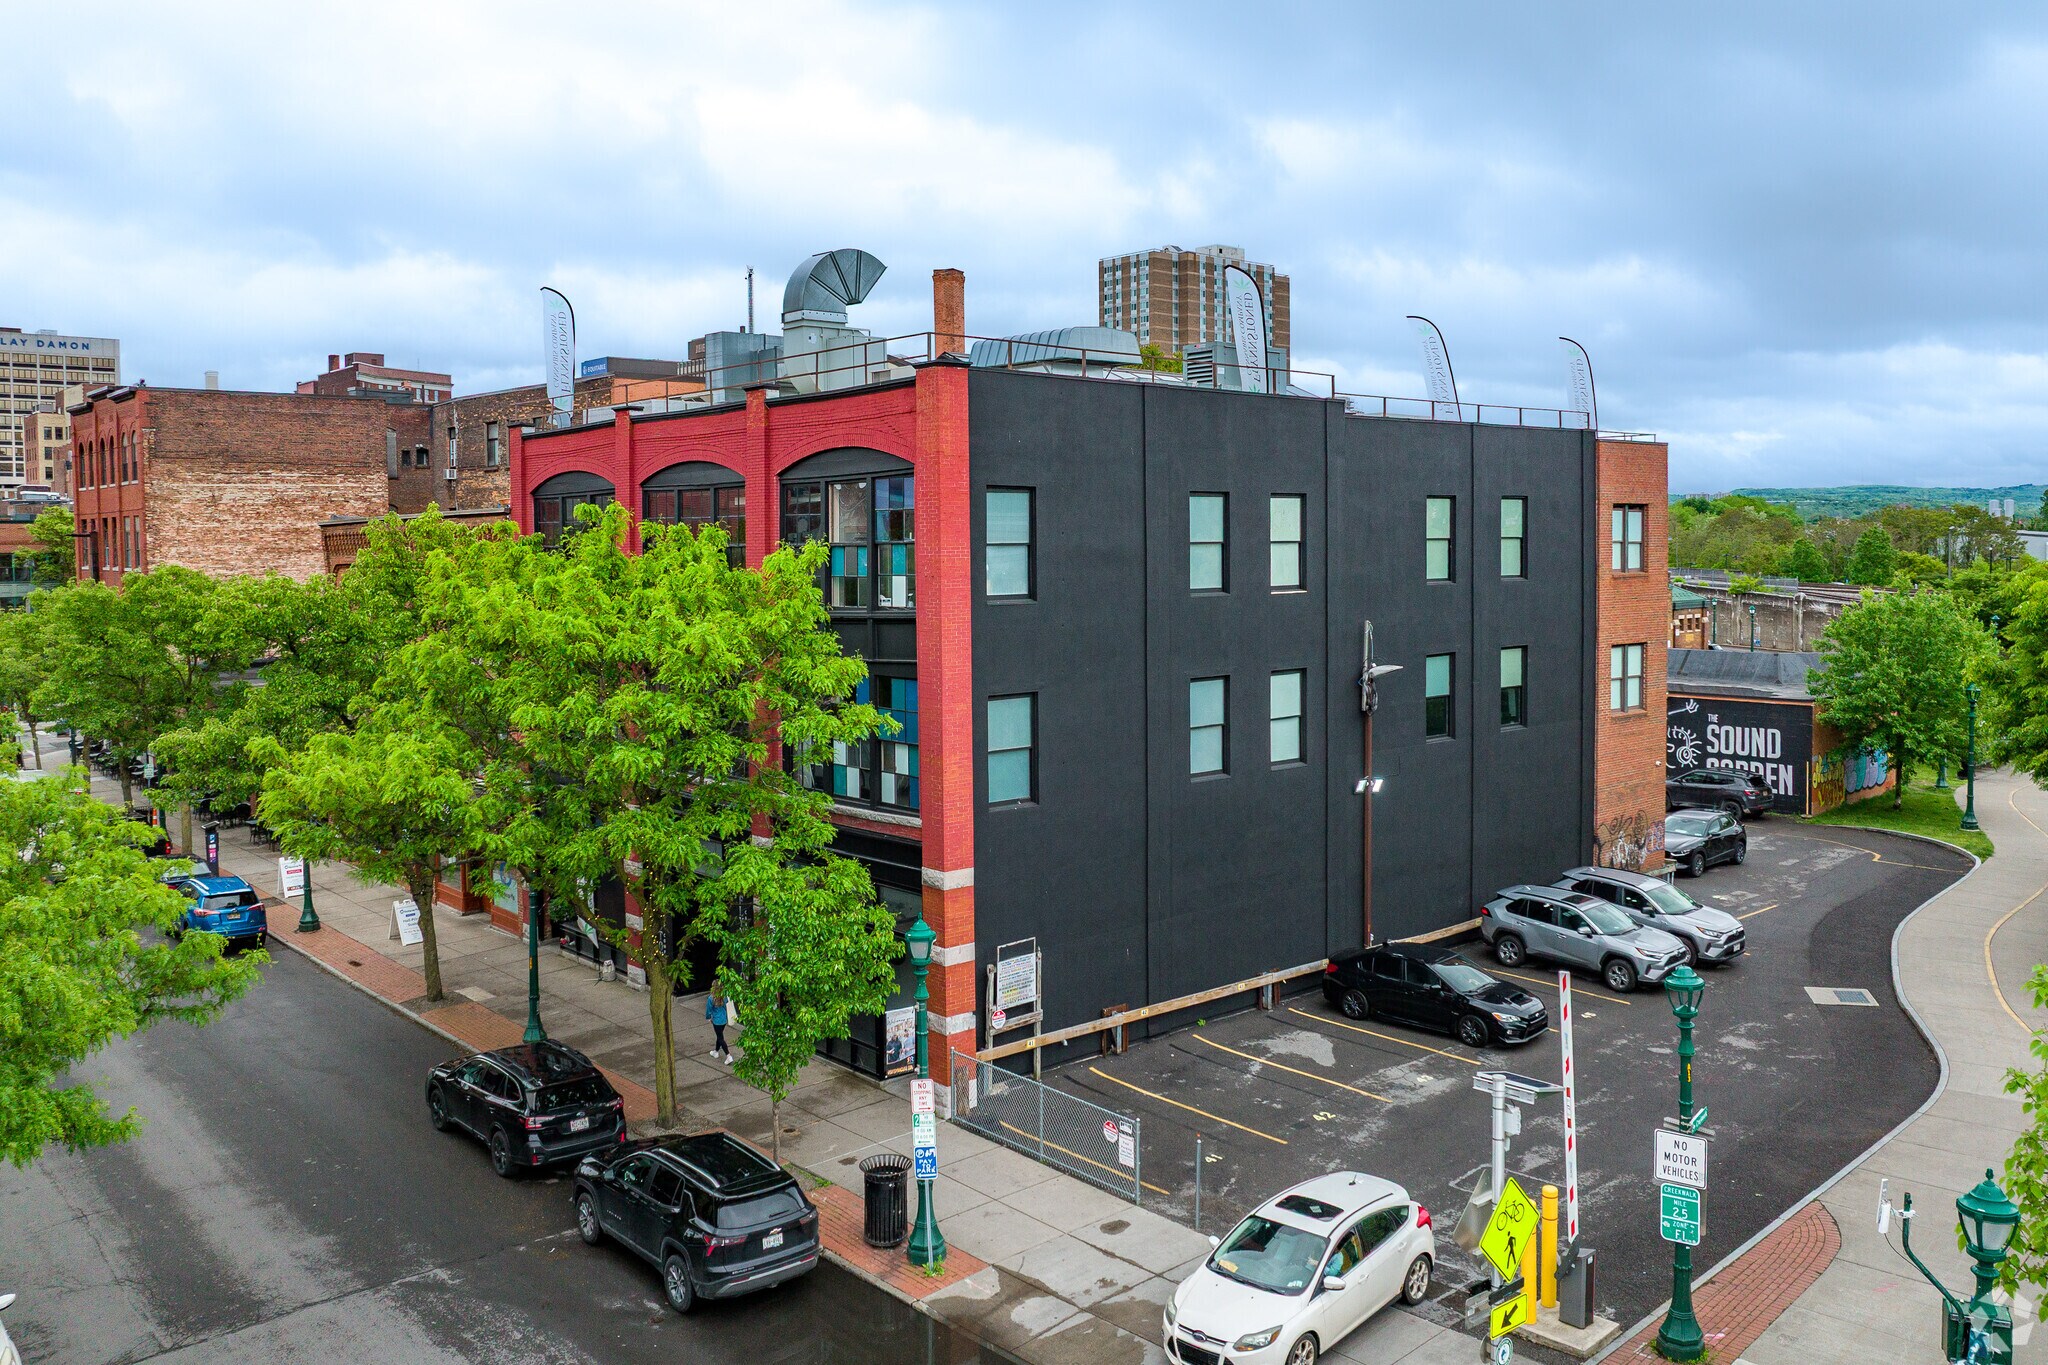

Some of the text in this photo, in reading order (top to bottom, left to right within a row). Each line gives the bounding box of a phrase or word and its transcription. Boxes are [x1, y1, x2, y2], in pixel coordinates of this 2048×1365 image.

[36, 340, 90, 351] DAMON
[587, 363, 607, 373] EQUITABLE
[1707, 713, 1719, 724] THE
[1706, 724, 1782, 759] SOUND
[914, 1114, 920, 1126] 2
[1312, 1111, 1336, 1122] 42
[1673, 1140, 1688, 1151] NO
[1205, 1153, 1223, 1164] 41
[1664, 1152, 1697, 1167] MOTOR
[1662, 1165, 1699, 1181] VEHICLES
[1663, 1186, 1697, 1199] CREEKWALK
[1673, 1199, 1687, 1208] MILE
[1672, 1220, 1687, 1229] ZONE
